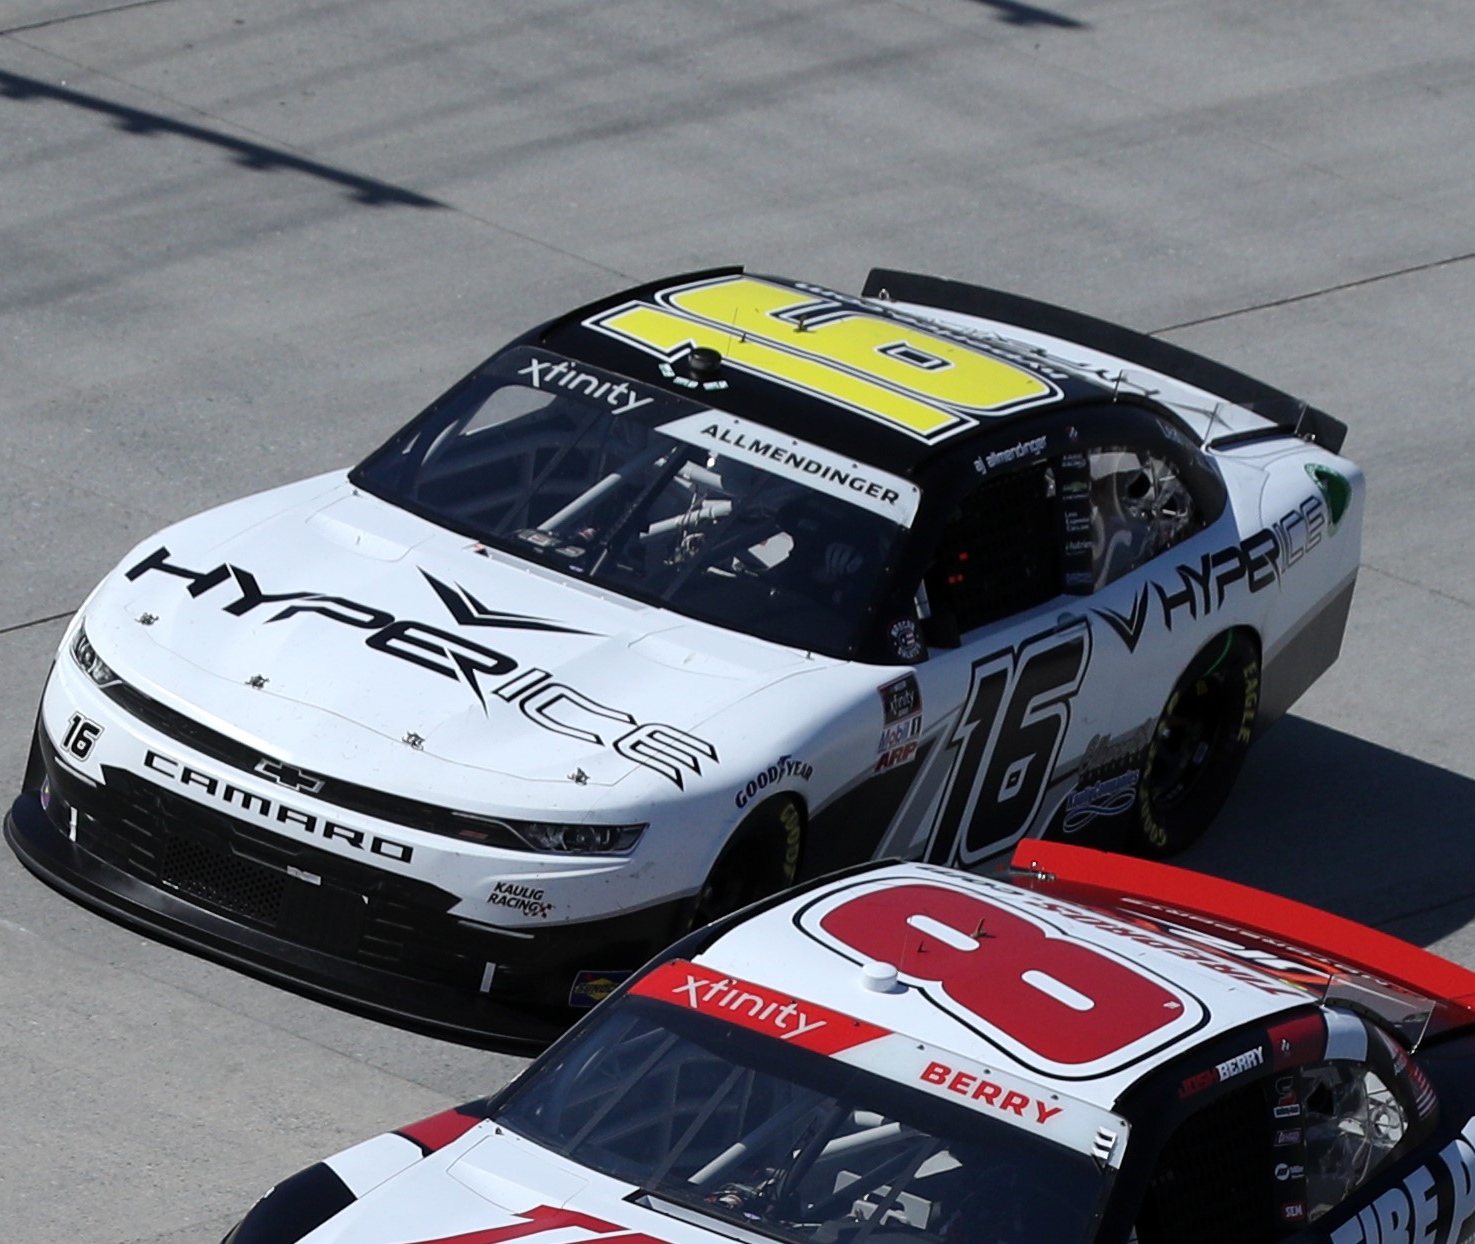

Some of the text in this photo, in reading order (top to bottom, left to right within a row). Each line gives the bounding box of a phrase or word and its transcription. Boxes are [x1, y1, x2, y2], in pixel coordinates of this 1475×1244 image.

[519, 358, 654, 415] xfinity
[582, 273, 1066, 446] 16
[700, 423, 900, 506] ALLMENDINGER
[1151, 495, 1326, 631] HYPERICE
[124, 547, 720, 791] HYPERICE
[61, 713, 103, 760] 16
[875, 741, 917, 771] ARP
[919, 613, 1094, 868] 16
[144, 749, 414, 864] CAMARO
[735, 754, 814, 808] GOODYEAR
[487, 892, 541, 916] RACING
[493, 881, 545, 901] KAULIG
[816, 880, 1186, 1067] 8
[672, 974, 827, 1039] xfinity
[920, 1060, 1065, 1126] BERRY
[1215, 1046, 1264, 1082] BERRY
